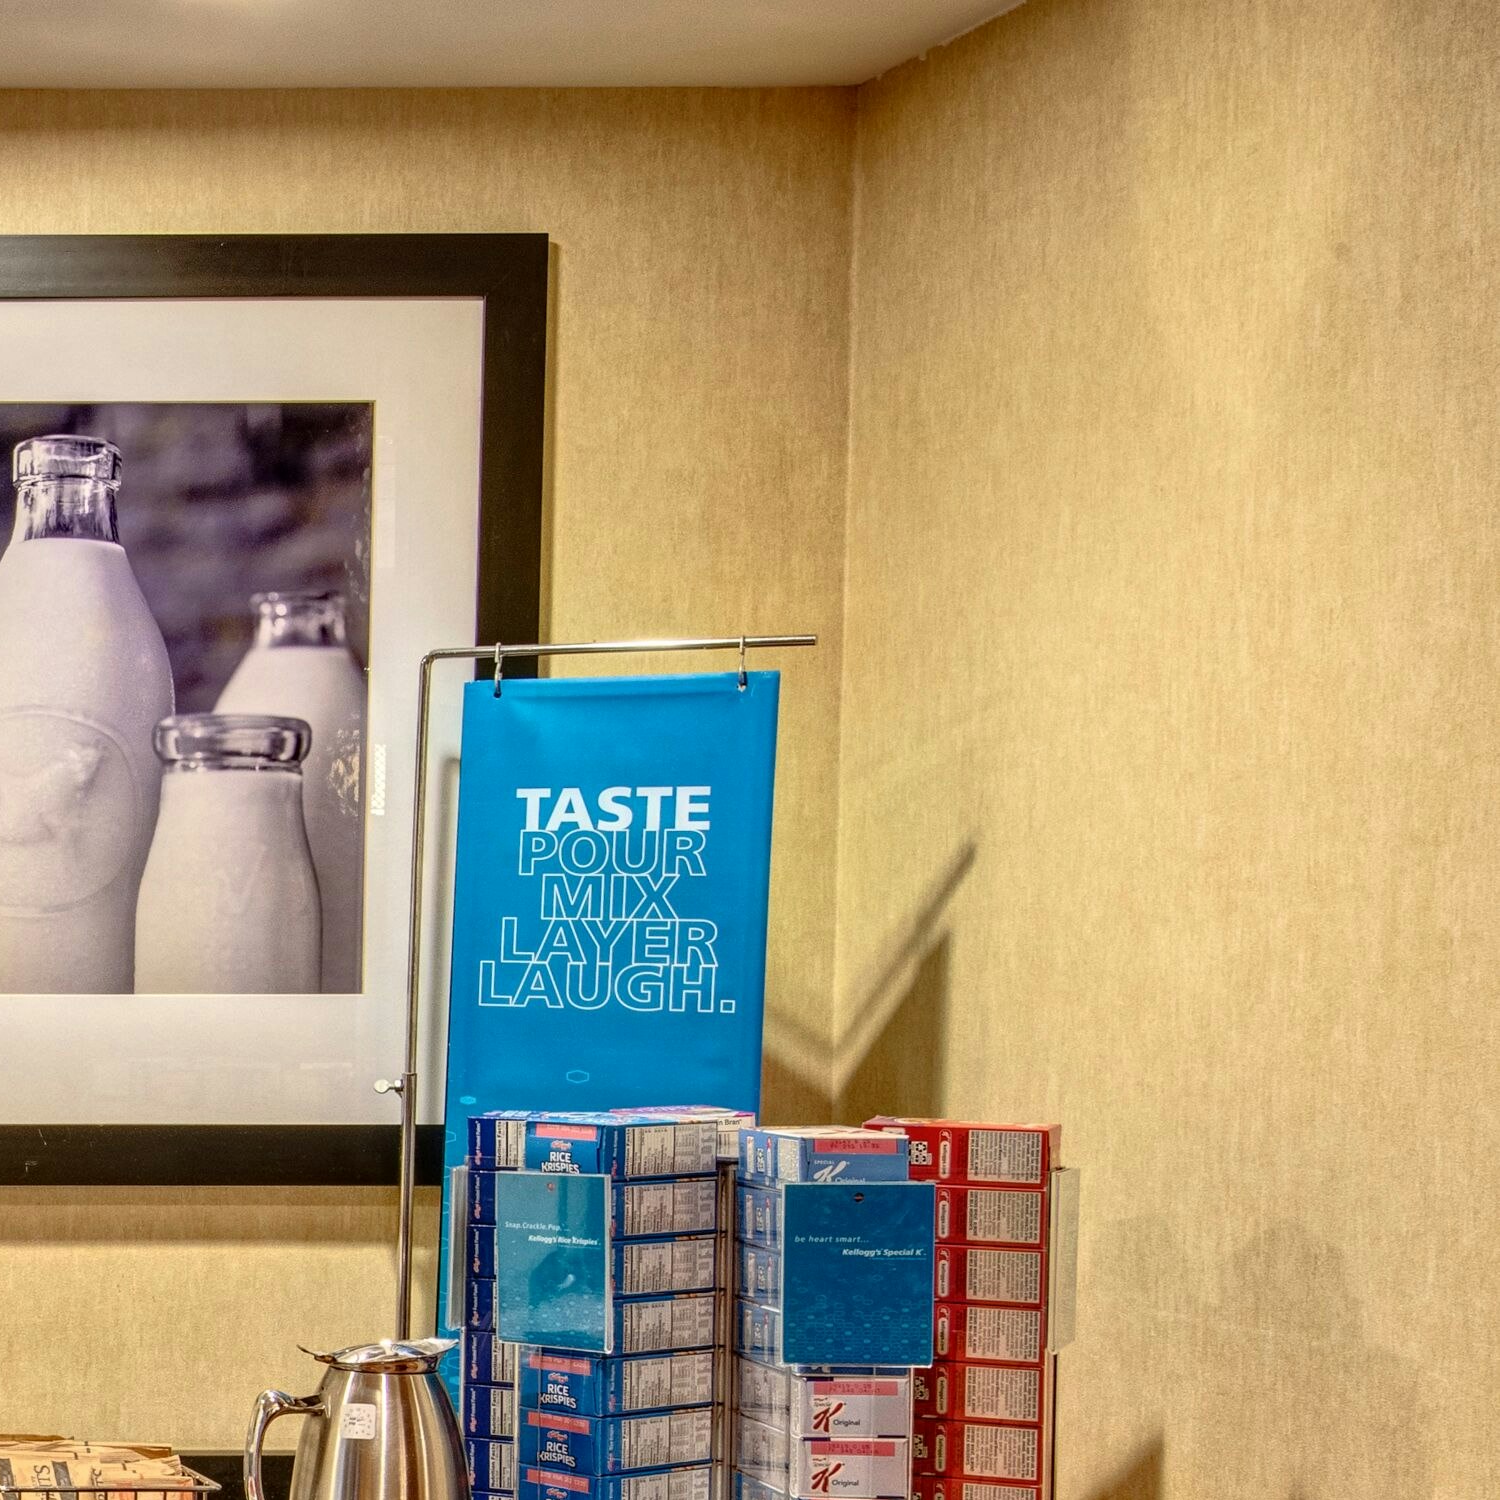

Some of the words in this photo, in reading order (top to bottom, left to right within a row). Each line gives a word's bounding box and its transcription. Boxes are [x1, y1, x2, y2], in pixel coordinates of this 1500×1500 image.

[516, 786, 711, 831] TASTE
[519, 828, 706, 876] POUR
[541, 874, 679, 920] MIX
[500, 917, 718, 967] LAYER
[478, 961, 735, 1014] LAUGH.
[550, 1152, 571, 1163] RICE
[541, 1162, 580, 1174] KRISPIES
[813, 1160, 847, 1182] K
[794, 1235, 805, 1243] be
[808, 1235, 833, 1243] heart
[842, 1249, 881, 1257] Kellogg's
[883, 1249, 914, 1257] Special
[547, 1383, 569, 1397] RICE
[539, 1393, 577, 1409] KRISPIES
[813, 1402, 843, 1433] K
[833, 1419, 860, 1427] Original
[546, 1441, 569, 1455] RICE
[537, 1451, 576, 1468] KRISPIES
[811, 1463, 842, 1493] K
